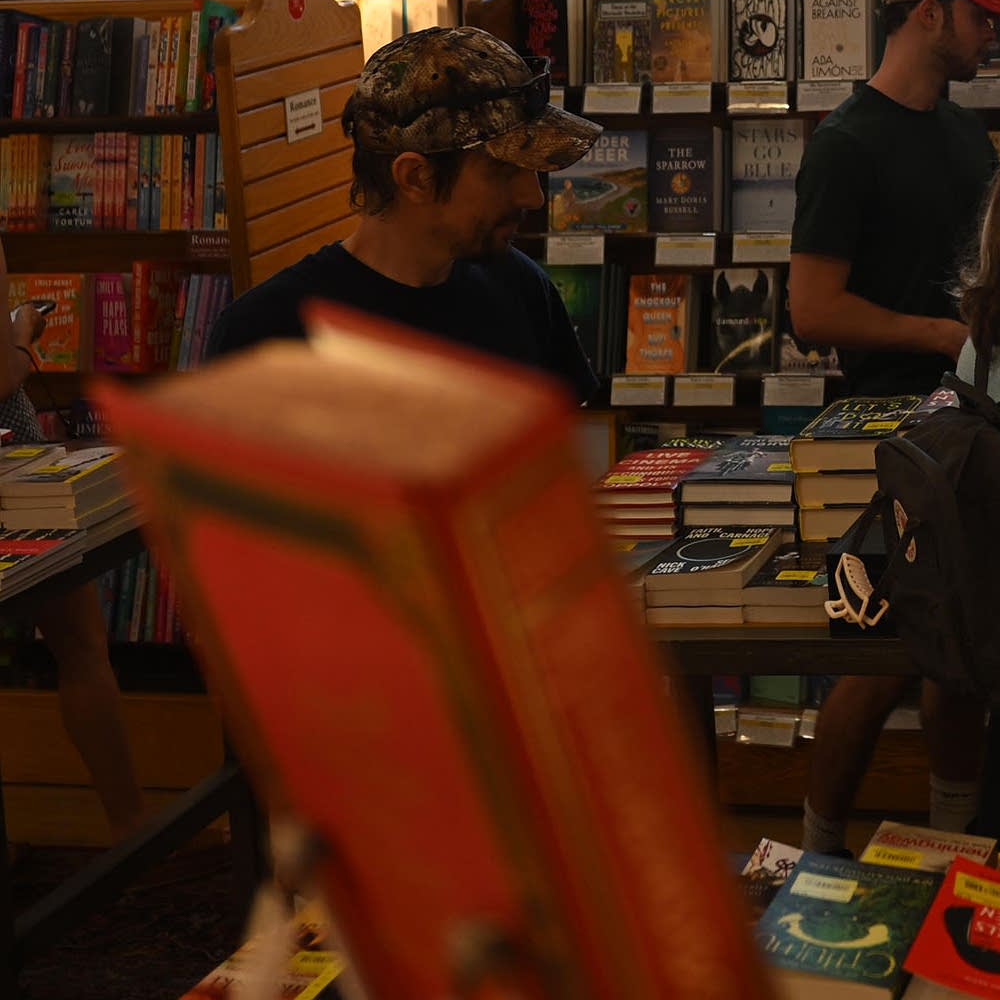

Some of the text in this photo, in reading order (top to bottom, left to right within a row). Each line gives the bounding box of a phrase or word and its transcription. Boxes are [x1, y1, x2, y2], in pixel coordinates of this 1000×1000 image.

[811, 8, 861, 20] BREAKING
[811, 55, 833, 66] ADA
[738, 126, 798, 144] STARS
[667, 147, 694, 158] THE
[753, 145, 782, 161] GO
[655, 159, 707, 171] SPARROW
[743, 162, 794, 179] BLUE
[58, 207, 93, 217] CARLE
[54, 217, 93, 226] FORTUN
[191, 234, 231, 246] Roman
[650, 281, 667, 294] THE
[642, 311, 673, 322] QUEEN
[646, 451, 692, 459] LIVE
[617, 458, 701, 466] CINEMA
[656, 561, 687, 569] NICK
[651, 567, 683, 575] CAVE
